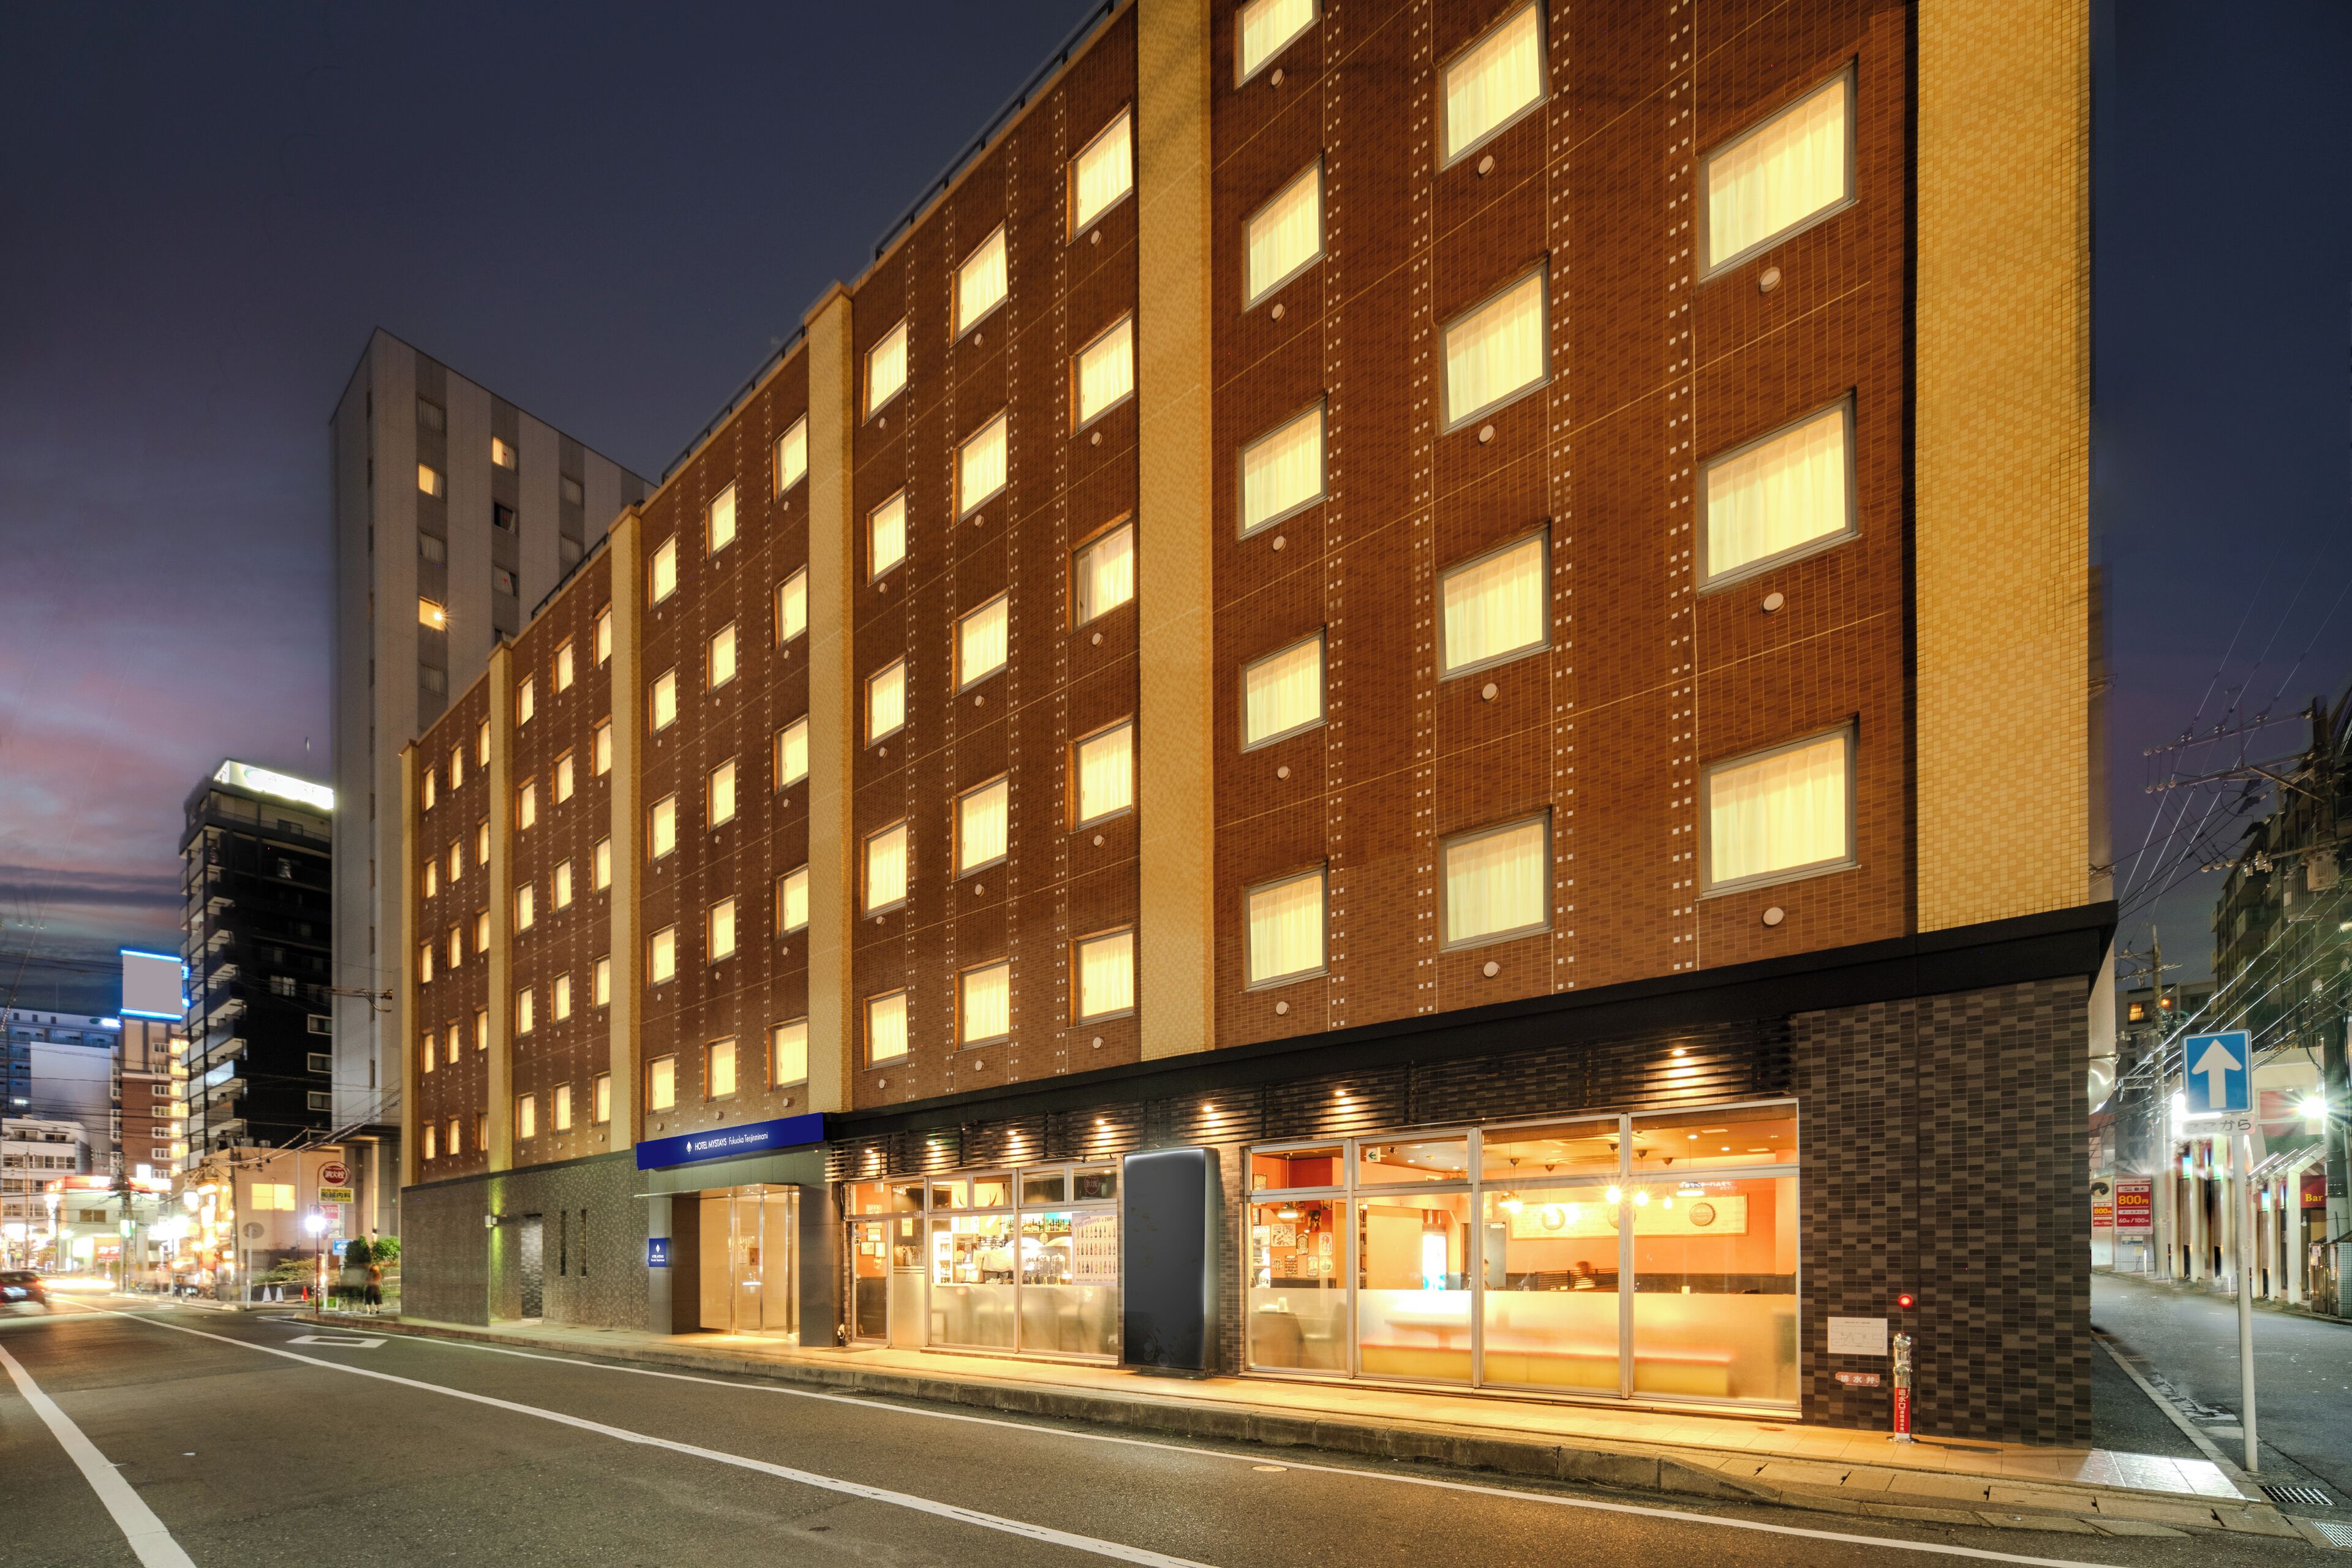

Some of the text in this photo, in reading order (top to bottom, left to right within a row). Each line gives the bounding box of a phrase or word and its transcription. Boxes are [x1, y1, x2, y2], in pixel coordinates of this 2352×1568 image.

[2186, 1119, 2251, 1134] ここから
[695, 1132, 768, 1151] HOTEL MYSTAYS Fukuoka Tenjinminami
[325, 1170, 345, 1179] 消火栓
[2119, 1195, 2149, 1205] 800円
[2305, 1193, 2323, 1202] Bar
[1841, 1374, 1875, 1384] 排水弁
